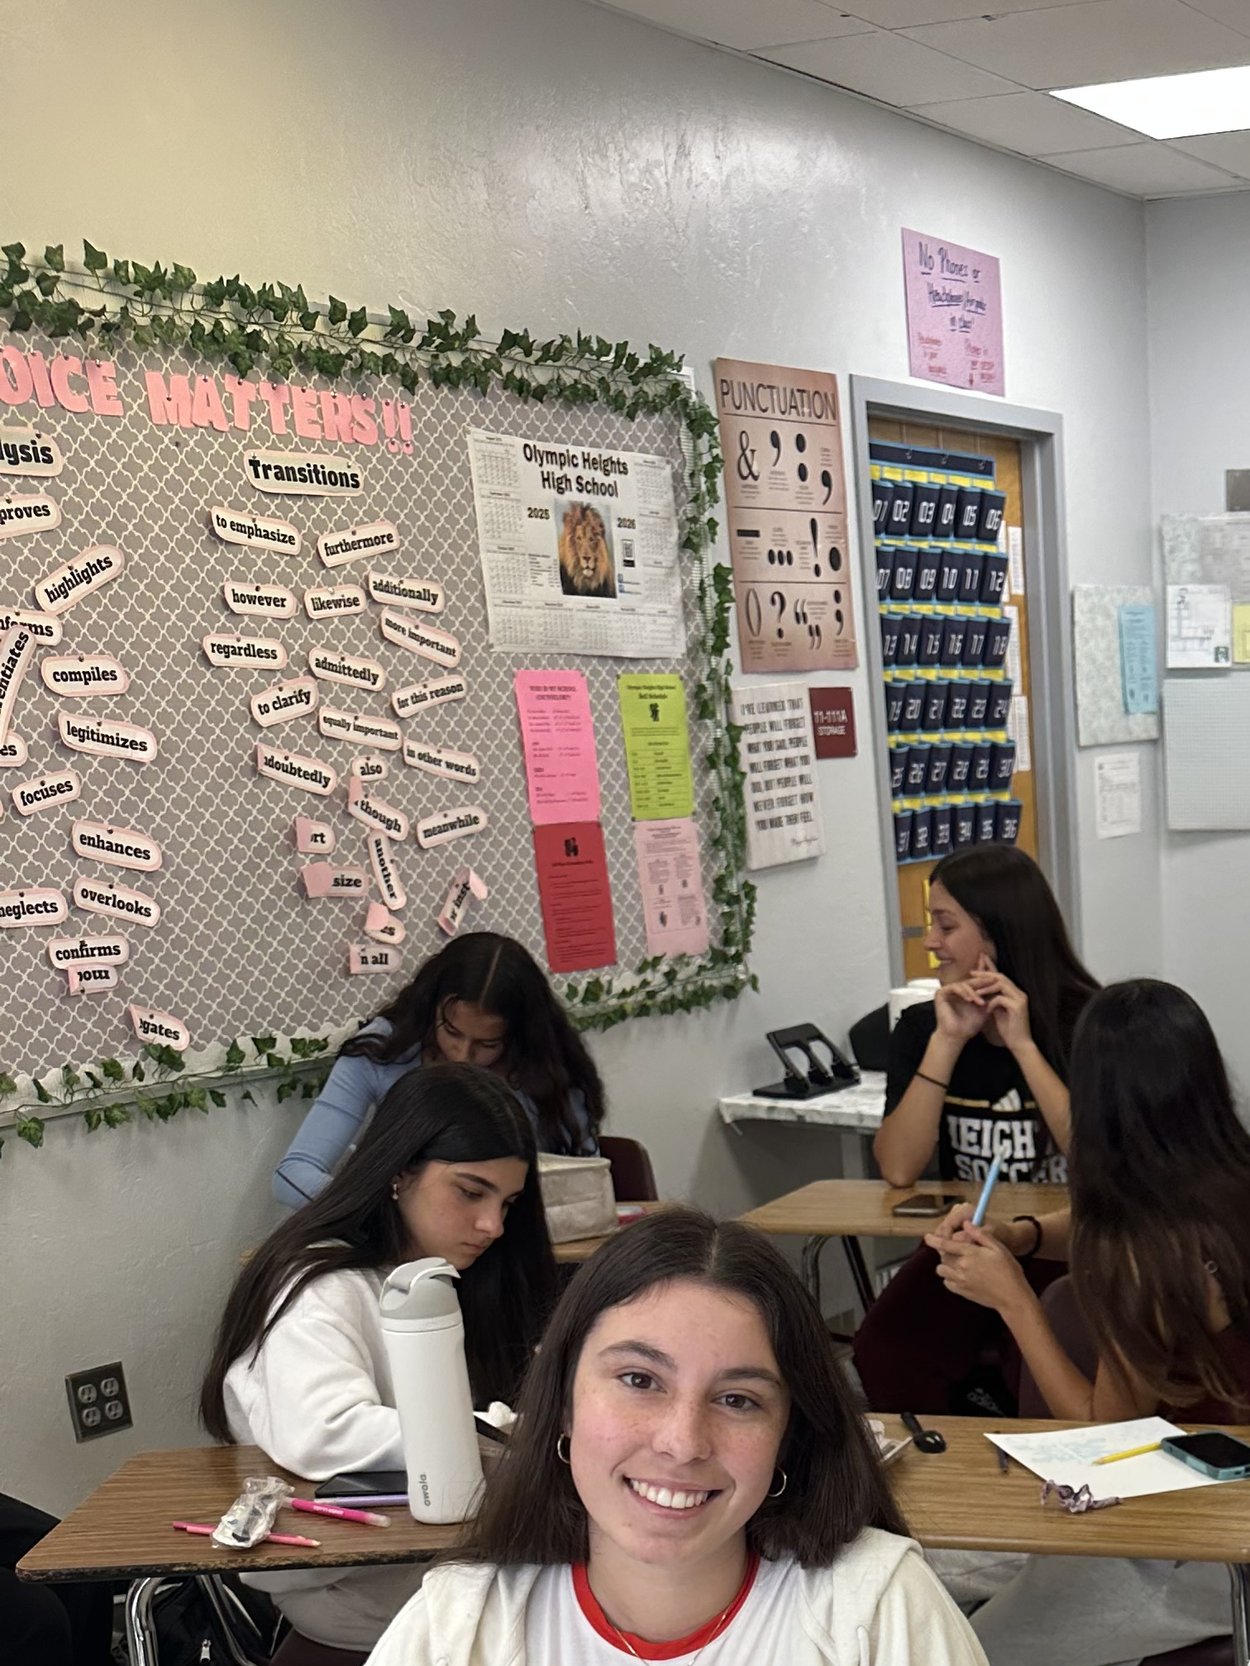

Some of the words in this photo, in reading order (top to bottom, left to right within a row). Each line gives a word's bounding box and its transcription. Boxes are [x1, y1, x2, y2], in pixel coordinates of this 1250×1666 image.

[721, 379, 836, 420] PUNCTUATION
[145, 371, 414, 455] MATTERS!!
[523, 443, 579, 470] Olympic
[582, 451, 629, 476] Heights
[249, 458, 361, 490] Transitions
[541, 471, 573, 494] High
[576, 475, 619, 497] School
[527, 507, 550, 519] 2025
[874, 500, 888, 521] 01
[892, 500, 910, 522] 02
[918, 501, 936, 523] 03
[963, 505, 978, 526] 05
[216, 515, 228, 530] to
[229, 518, 297, 546] emphasize
[324, 531, 395, 557] furthermore
[45, 555, 113, 603] highlights
[877, 568, 891, 590] 07
[895, 567, 913, 589] 08
[920, 568, 936, 590] 09
[942, 567, 958, 589] 10
[965, 568, 979, 590] 11
[232, 591, 287, 608] however
[311, 594, 360, 612] likewise
[372, 579, 438, 606] additionally
[384, 616, 407, 635] more
[408, 628, 456, 657] important
[884, 635, 897, 655] 13
[903, 634, 918, 654] 14
[927, 634, 940, 655] 15
[949, 635, 963, 655] 16
[970, 634, 984, 654] 17
[210, 642, 278, 661] regardless
[53, 666, 118, 685] compiles
[315, 656, 379, 685] admittedly
[258, 702, 270, 716] to
[271, 688, 312, 711] clarify
[410, 691, 428, 705] this
[429, 682, 464, 699] reason
[905, 699, 921, 719] 20
[929, 699, 944, 719] 21
[951, 698, 966, 718] 22
[66, 720, 148, 752] legitimizes
[323, 715, 351, 732] equally
[352, 719, 399, 741] important
[359, 762, 383, 776] also
[407, 745, 416, 758] in
[417, 751, 443, 767] other
[445, 759, 477, 777] words
[931, 762, 947, 781] 27
[953, 761, 969, 780] 28
[998, 759, 1012, 778] 30
[908, 763, 924, 783] 26
[20, 779, 74, 806] focuses
[360, 799, 401, 833] though
[423, 814, 480, 839] meanwhile
[958, 822, 972, 841] 34
[79, 833, 151, 860] enhances
[374, 838, 398, 900] another
[0, 901, 58, 919] neglects
[80, 886, 152, 917] overlooks
[55, 943, 121, 961] confirms
[421, 1473, 432, 1507] owala
